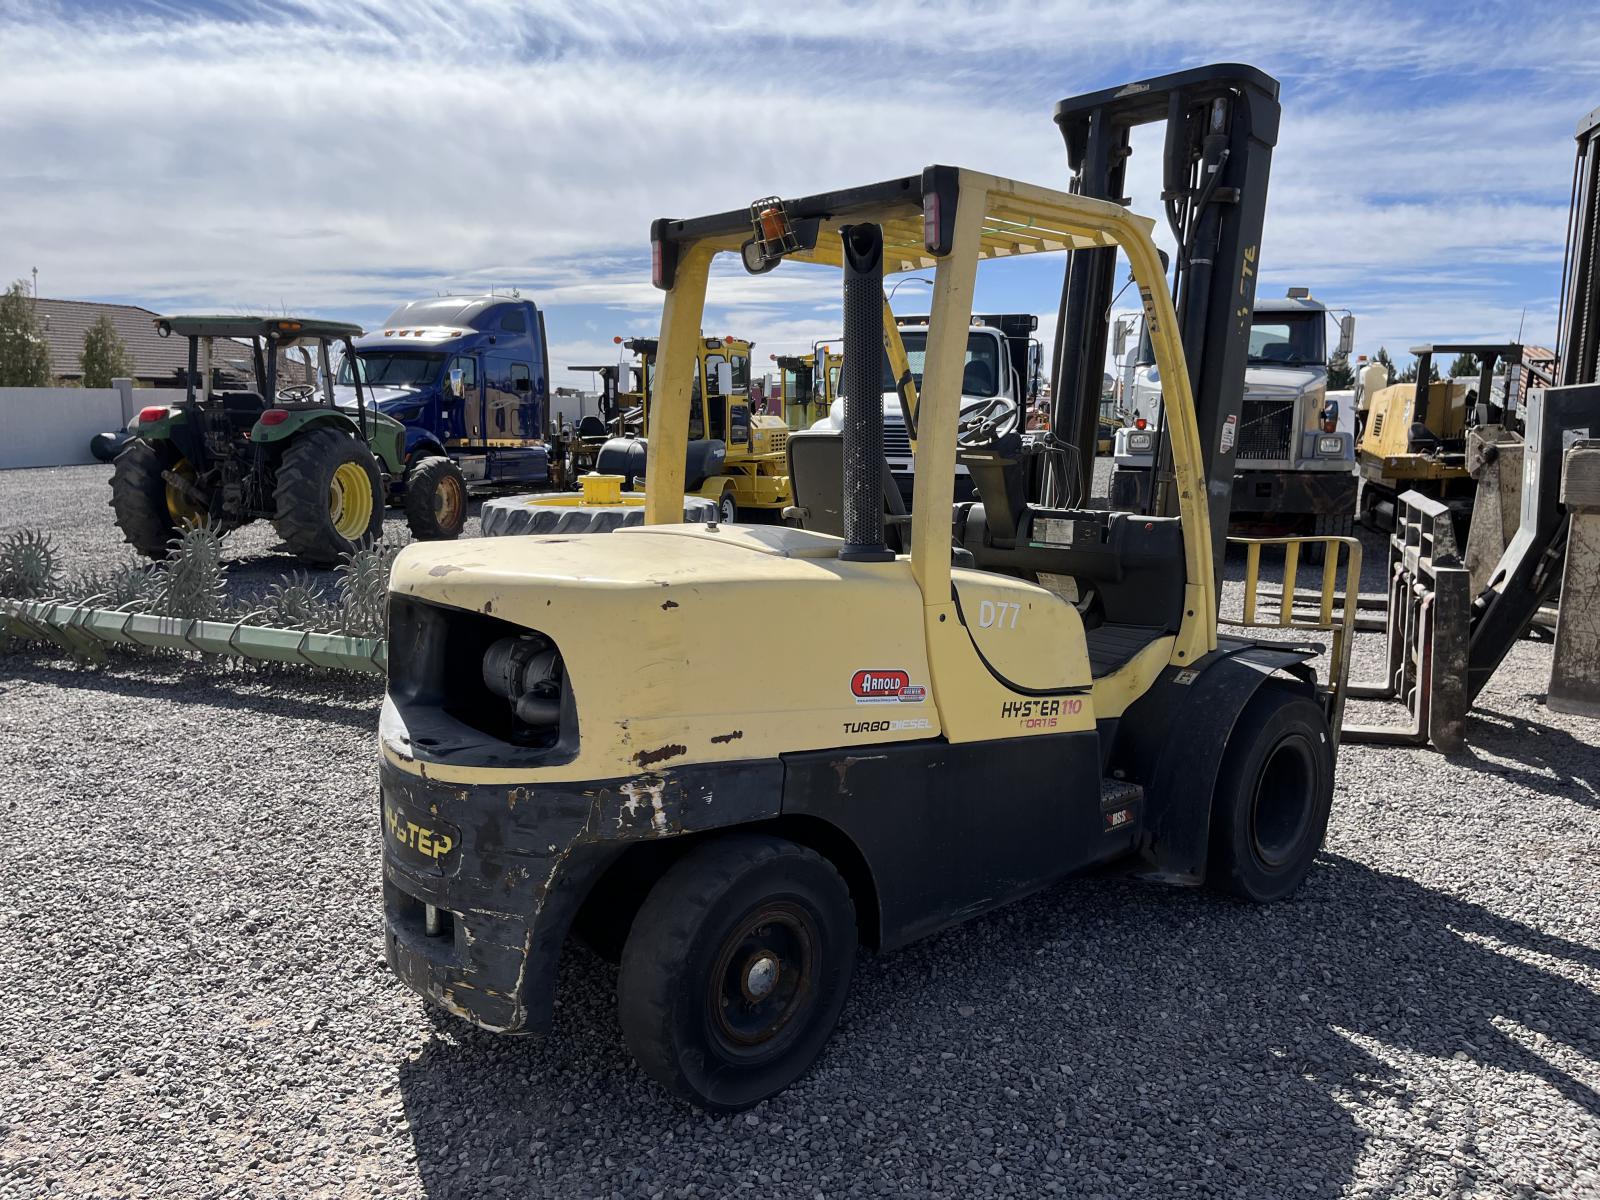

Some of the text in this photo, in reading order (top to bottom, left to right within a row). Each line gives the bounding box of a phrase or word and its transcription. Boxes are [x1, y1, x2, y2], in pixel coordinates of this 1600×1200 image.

[979, 600, 1021, 629] D77
[861, 673, 901, 692] ARNOLD
[1001, 699, 1083, 718] HYSTER 110
